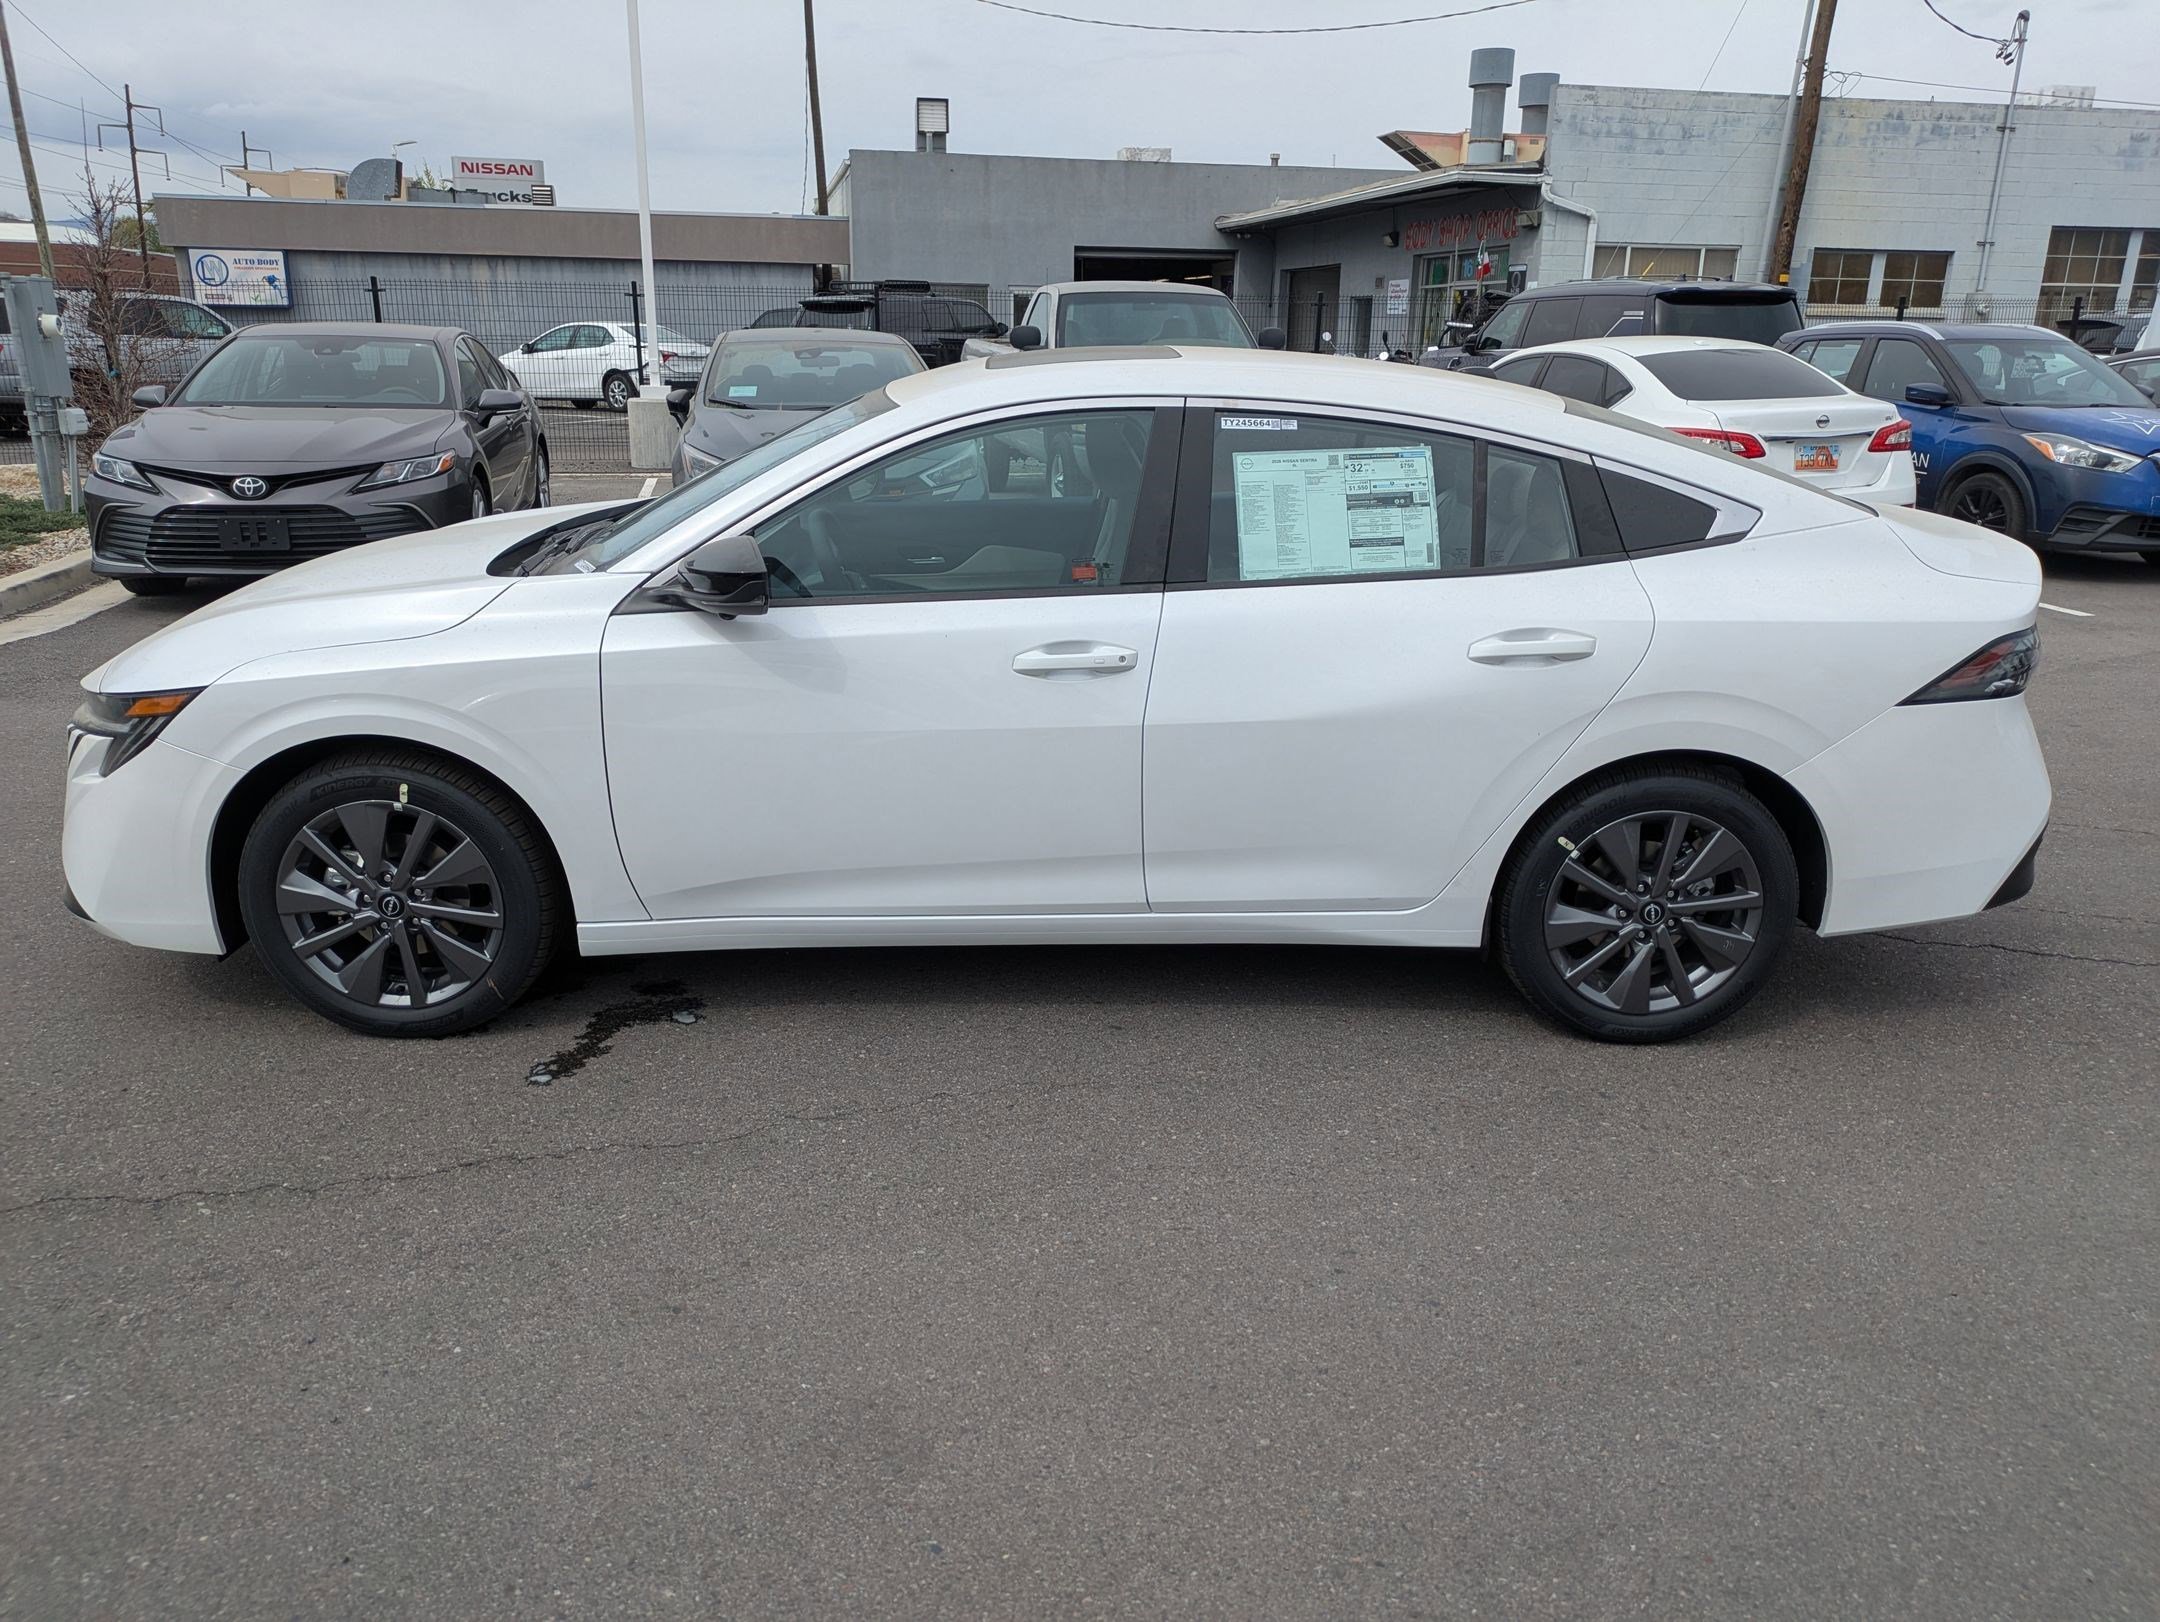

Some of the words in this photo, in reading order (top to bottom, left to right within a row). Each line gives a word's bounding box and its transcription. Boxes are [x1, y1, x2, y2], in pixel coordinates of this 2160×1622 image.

[461, 161, 533, 177] NISSAN
[1405, 222, 1435, 250] BODY
[1439, 214, 1472, 246] SHOP
[1476, 207, 1520, 241] OFFICE
[232, 256, 255, 266] AUTO
[256, 257, 280, 267] BODY
[1222, 418, 1271, 428] TY245664
[1350, 463, 1363, 473] 32
